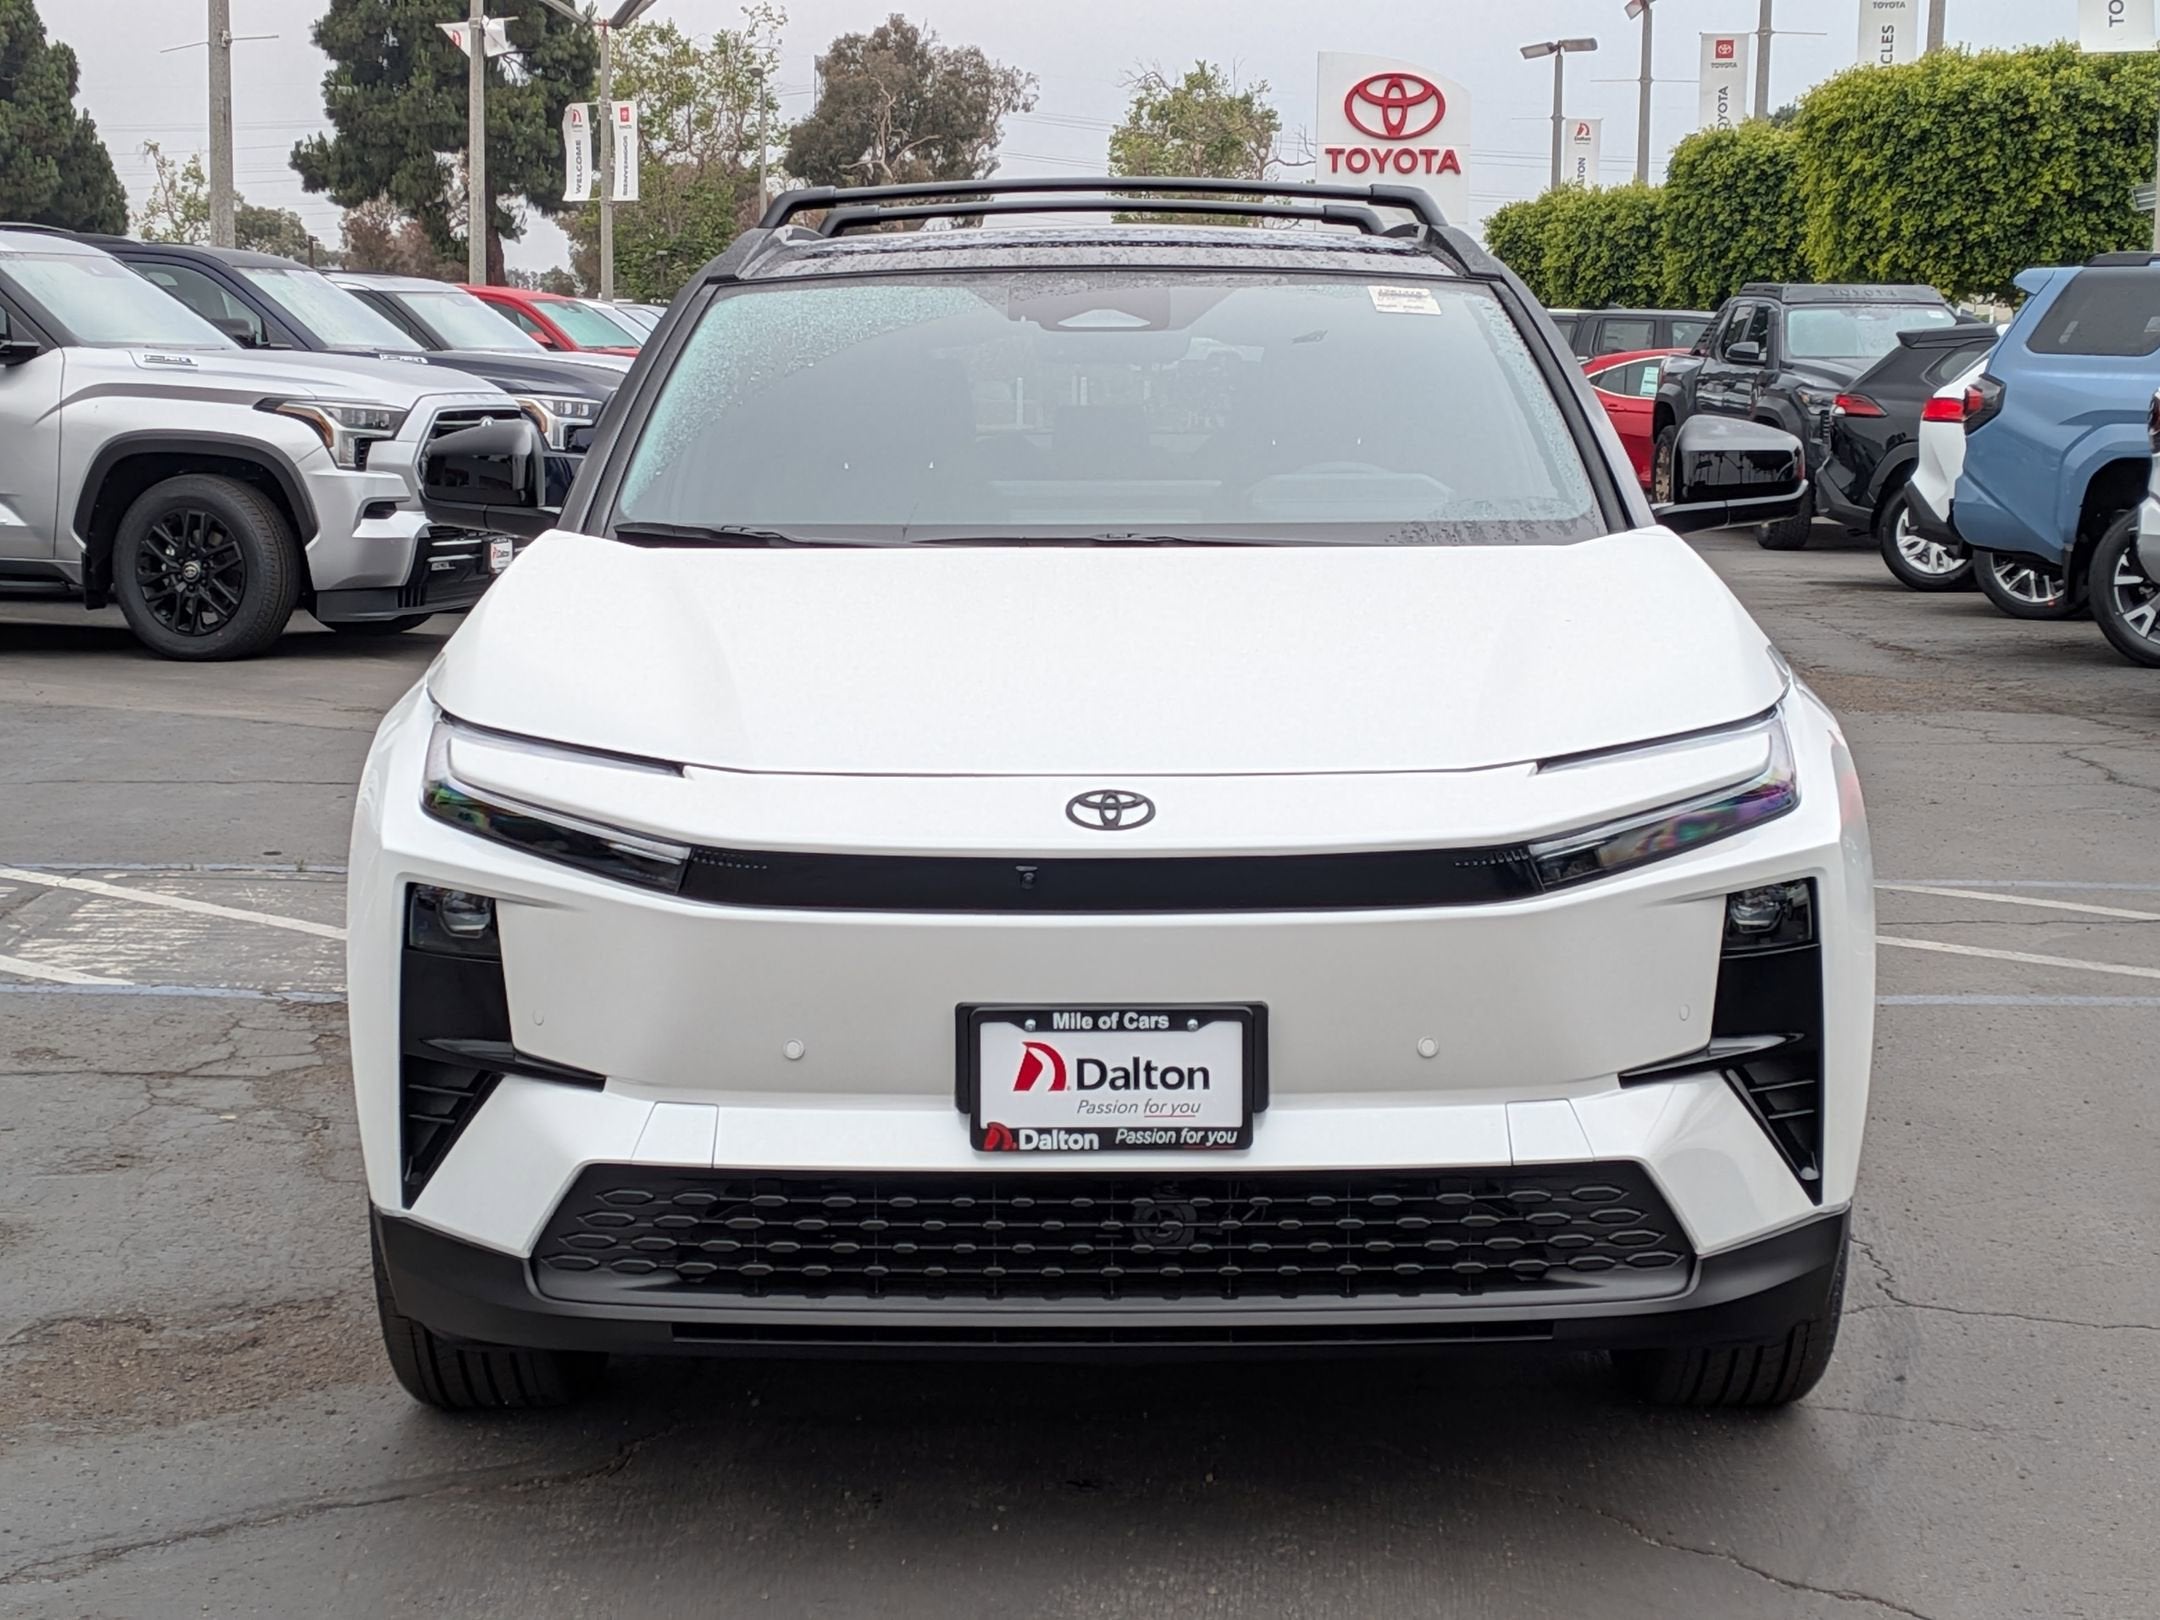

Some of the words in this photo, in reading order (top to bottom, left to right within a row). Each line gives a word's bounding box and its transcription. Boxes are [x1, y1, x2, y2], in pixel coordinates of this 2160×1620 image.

[1872, 1, 1906, 9] TOYOTA
[1880, 24, 1895, 68] CLES
[1717, 85, 1729, 131] OYOTA
[575, 139, 583, 194] WELCOME
[1325, 148, 1461, 174] TOYOTA
[1053, 1012, 1093, 1030] Mile
[1098, 1012, 1119, 1030] of
[1123, 1012, 1170, 1030] Cars
[1076, 1056, 1210, 1091] Dalton
[1076, 1099, 1138, 1115] Passion
[1144, 1098, 1168, 1115] for
[1169, 1102, 1201, 1116] you
[1018, 1129, 1100, 1150] Dalton
[1115, 1129, 1176, 1145] Passion
[1180, 1127, 1205, 1145] for
[1205, 1130, 1238, 1148] you
